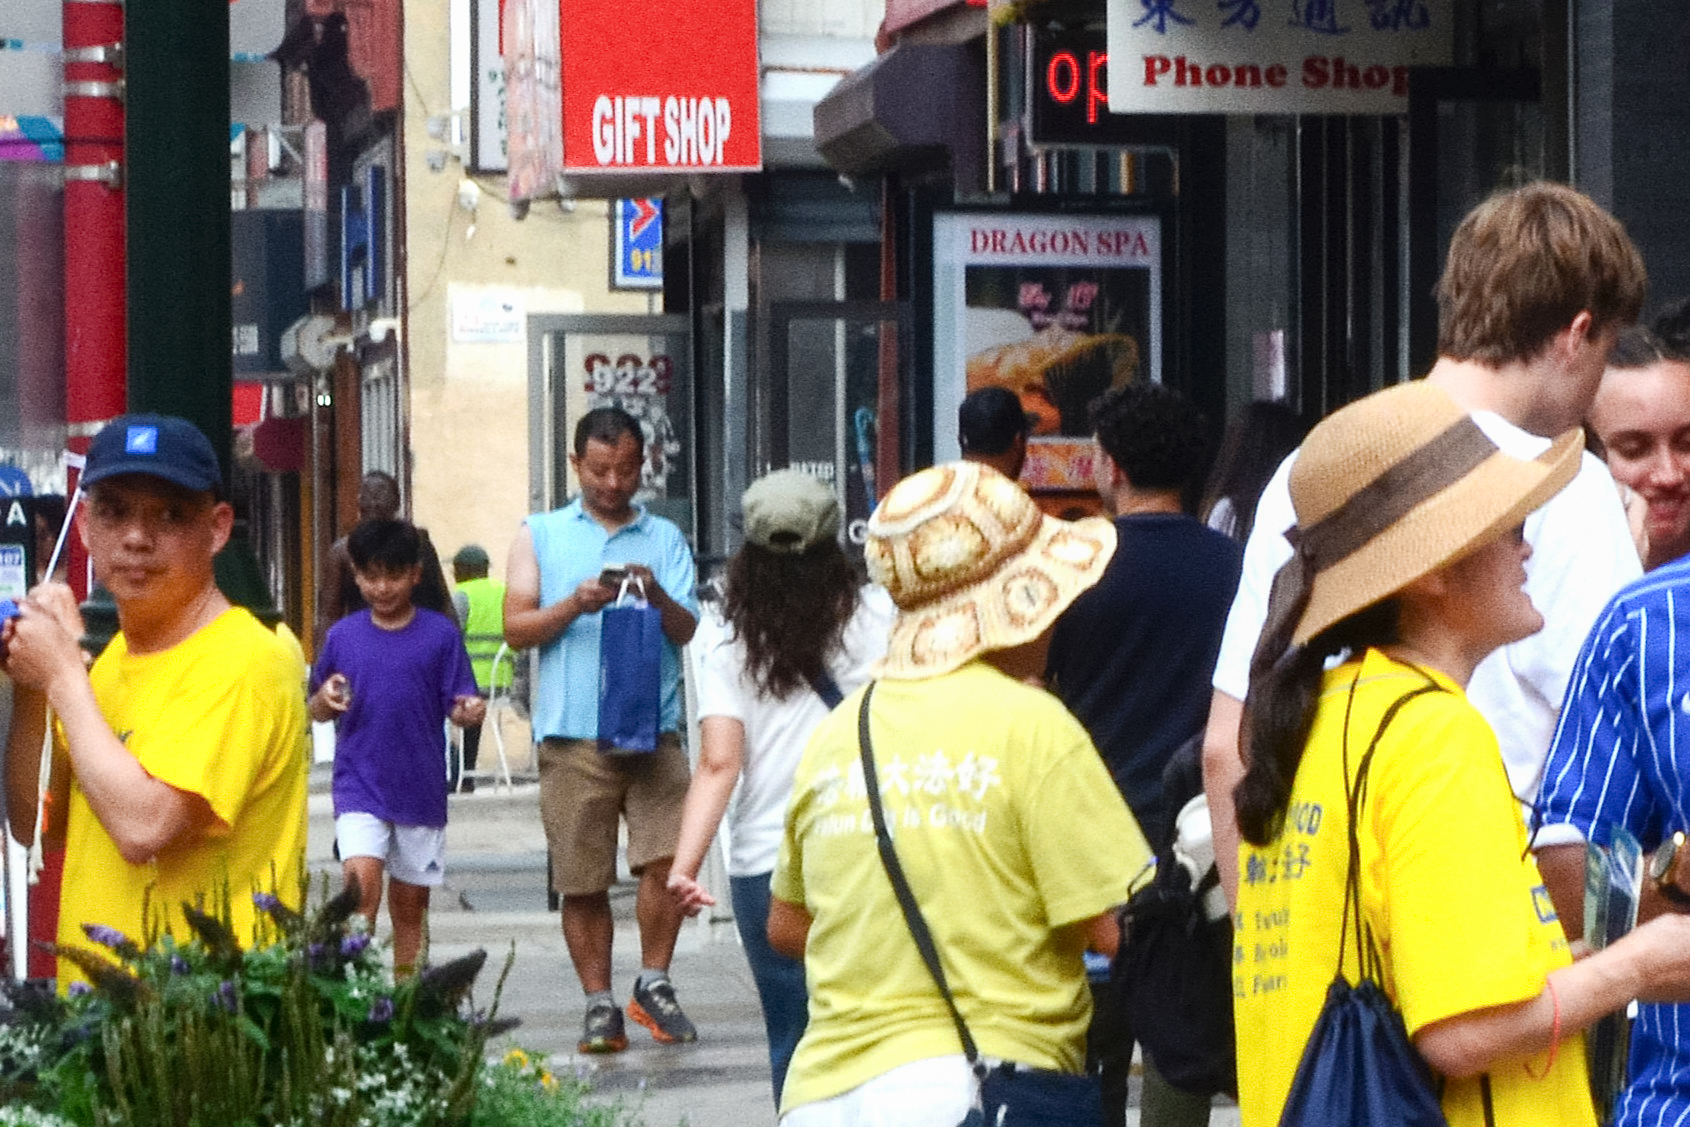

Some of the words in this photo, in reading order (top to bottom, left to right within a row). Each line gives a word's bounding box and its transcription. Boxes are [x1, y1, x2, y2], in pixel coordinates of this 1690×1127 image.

[1143, 55, 1288, 88] Phone
[592, 95, 660, 165] GIFT
[664, 96, 732, 165] SHOP
[971, 229, 1089, 254] DRAGON
[1096, 231, 1149, 256] SPA
